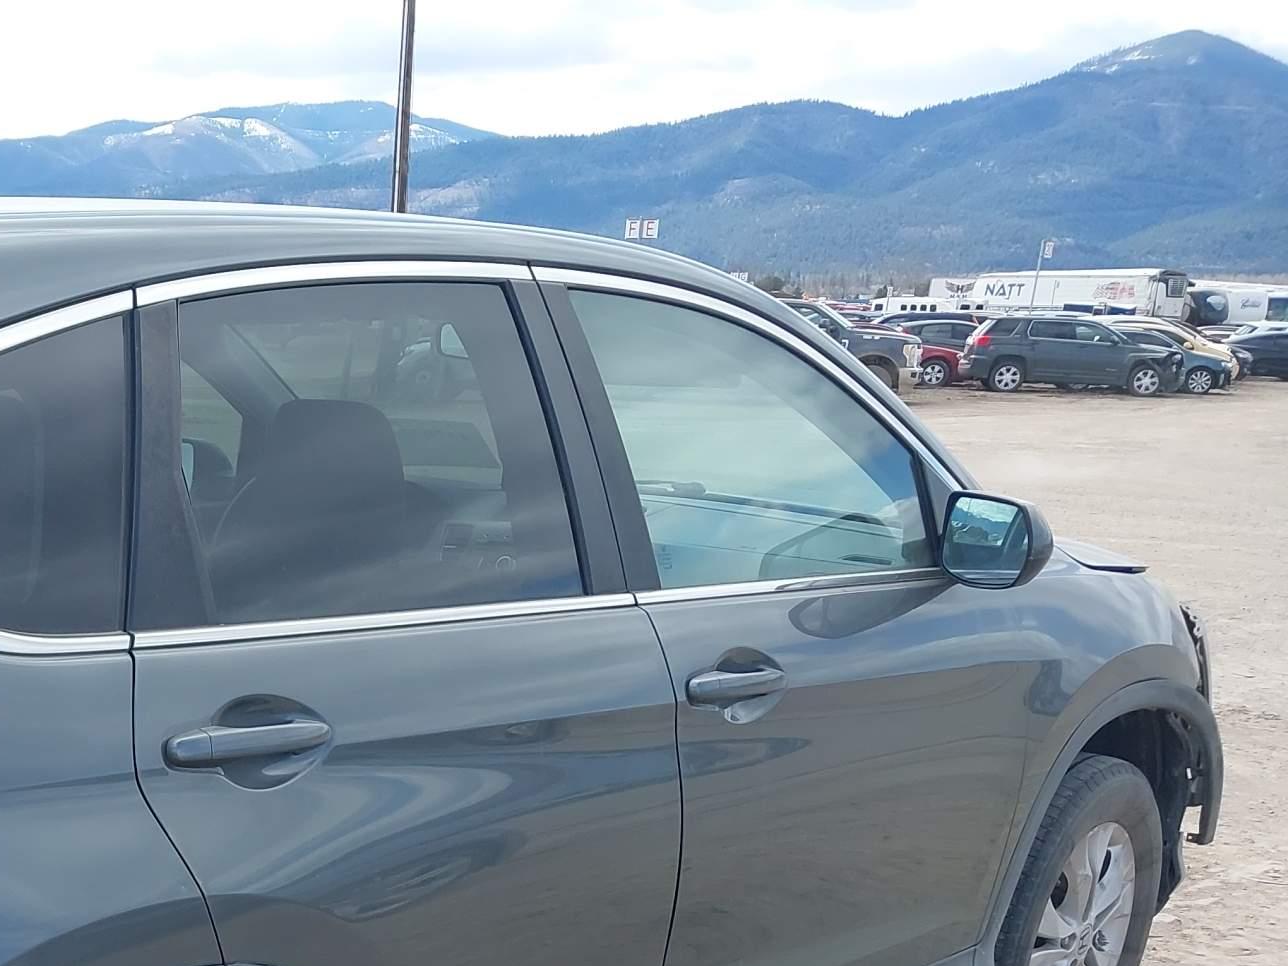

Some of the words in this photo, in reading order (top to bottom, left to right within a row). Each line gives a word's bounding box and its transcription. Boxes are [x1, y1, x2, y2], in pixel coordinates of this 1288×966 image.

[628, 221, 638, 237] F
[646, 221, 656, 237] E
[984, 281, 1025, 299] NATT
